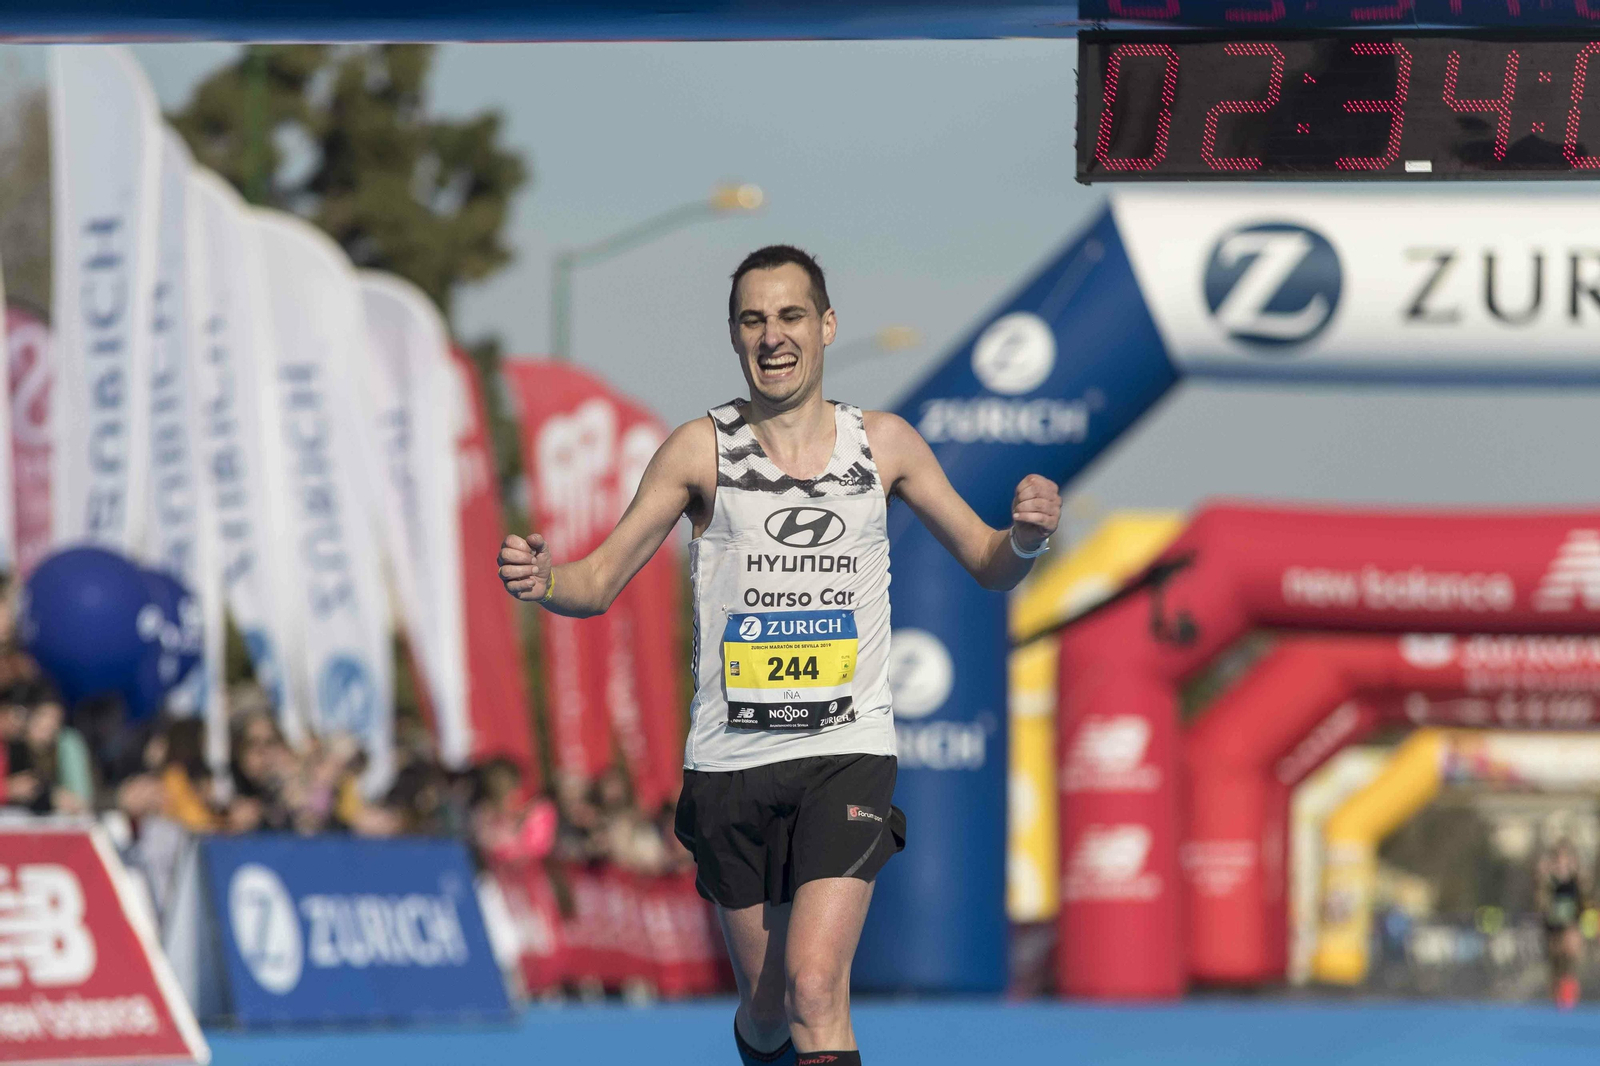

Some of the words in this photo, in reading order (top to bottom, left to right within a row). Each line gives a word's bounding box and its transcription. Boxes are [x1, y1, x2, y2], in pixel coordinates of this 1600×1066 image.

[747, 554, 858, 574] HYUNDAI
[743, 588, 812, 608] Oarso
[820, 587, 855, 606] Car
[766, 618, 842, 636] ZURICH
[767, 656, 820, 681] 244
[783, 689, 801, 700] IÑA
[820, 714, 850, 727] ZURICH
[303, 893, 469, 968] ZURICH
